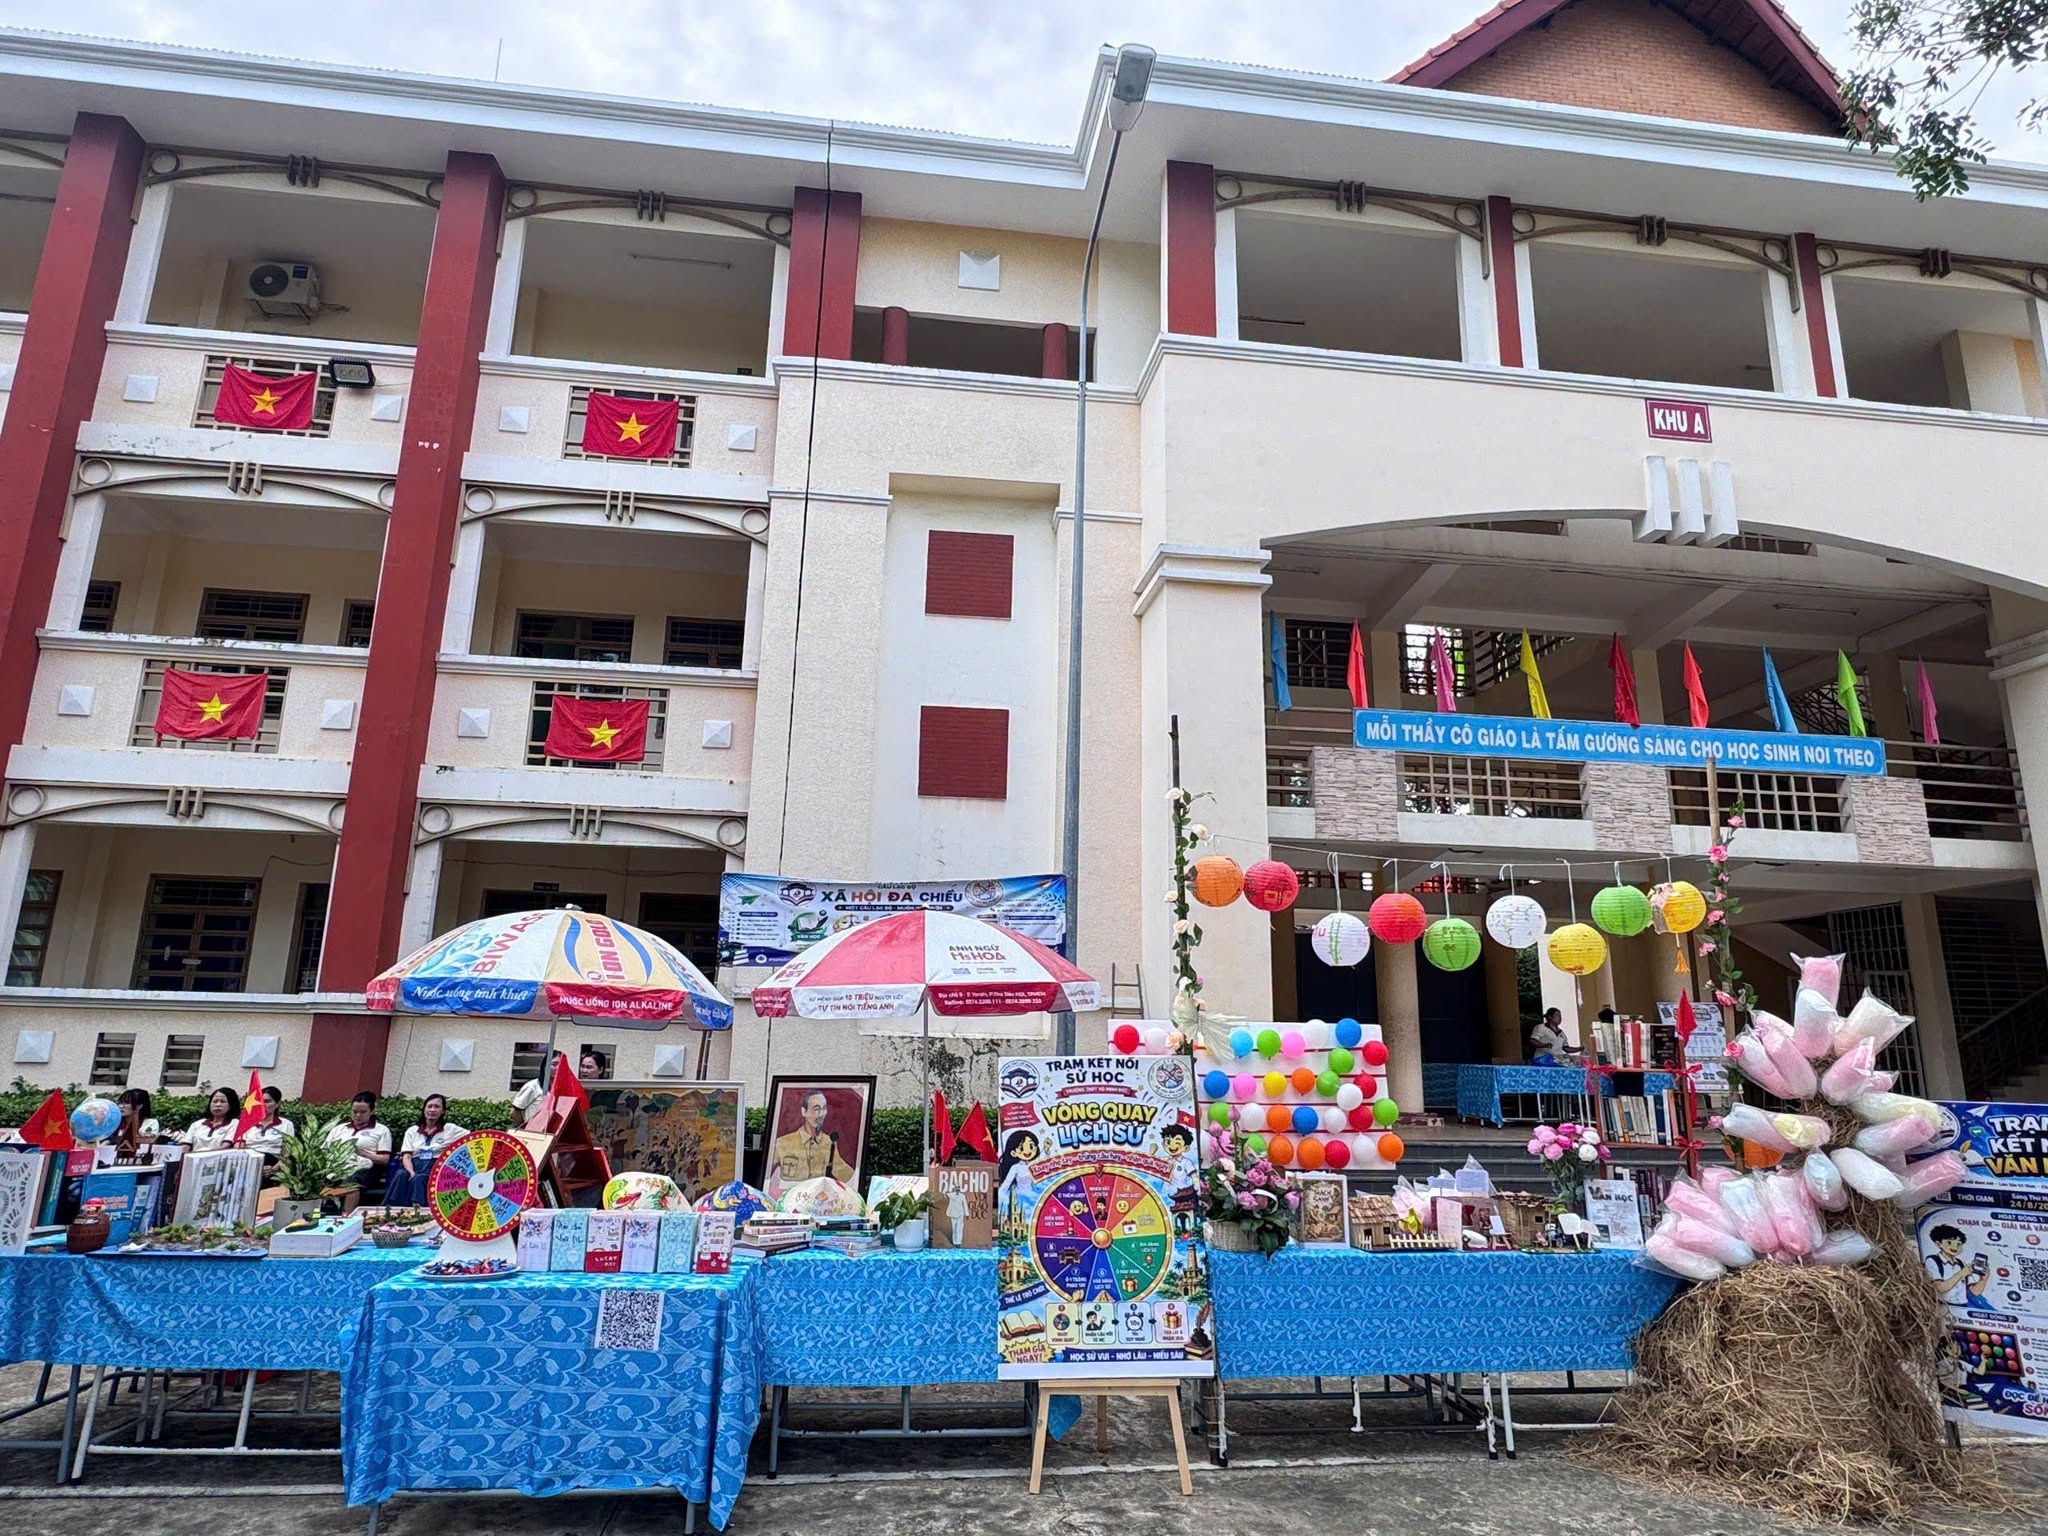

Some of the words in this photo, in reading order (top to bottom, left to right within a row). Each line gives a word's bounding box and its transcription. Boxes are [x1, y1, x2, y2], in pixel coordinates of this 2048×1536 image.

[1653, 408, 1687, 432] KHU
[1694, 413, 1705, 434] A
[1366, 715, 1397, 741] MỖI
[1401, 718, 1445, 743] THẦY
[1450, 722, 1472, 745] CÔ
[1478, 723, 1516, 748] GIÁO
[1521, 724, 1541, 749] LÀ
[1546, 726, 1580, 751] TẤM
[1584, 731, 1639, 754] GƯƠNG
[1643, 732, 1687, 757] SÁNG
[1691, 742, 1723, 759] CHO
[1728, 742, 1760, 764] HỌC
[1764, 744, 1800, 762] SINH
[1804, 746, 1830, 764] NOI
[1833, 748, 1874, 767] THEO
[821, 888, 847, 902] XÃ
[851, 889, 882, 905] HỘI
[887, 892, 913, 902] ĐA
[855, 993, 874, 1001] TRIỆU
[612, 1000, 627, 1009] ION
[630, 1001, 673, 1010] ALKALINE
[1046, 1061, 1086, 1073] TRẠM
[1087, 1058, 1115, 1069] KẾT
[1115, 1058, 1139, 1070] NỐI
[1066, 1071, 1088, 1084] SỬ
[1092, 1071, 1125, 1085] HỌC
[1042, 1101, 1100, 1125] VÒNG
[1102, 1102, 1159, 1124] QUAY
[1058, 1124, 1110, 1148] LỊCH
[1113, 1120, 1147, 1145] SỬ
[1989, 1134, 2035, 1153] KẾT
[1984, 1154, 2039, 1174] VĂN
[1976, 1194, 1994, 1202] GIAN
[1009, 1346, 1031, 1357] THAM
[1017, 1353, 1042, 1363] NGAY!
[1070, 1353, 1085, 1362] HỌC
[1086, 1351, 1097, 1360] SỬ
[1116, 1351, 1132, 1360] NHỚ
[1133, 1351, 1147, 1360] LÂU
[1171, 1351, 1183, 1359] SÂU
